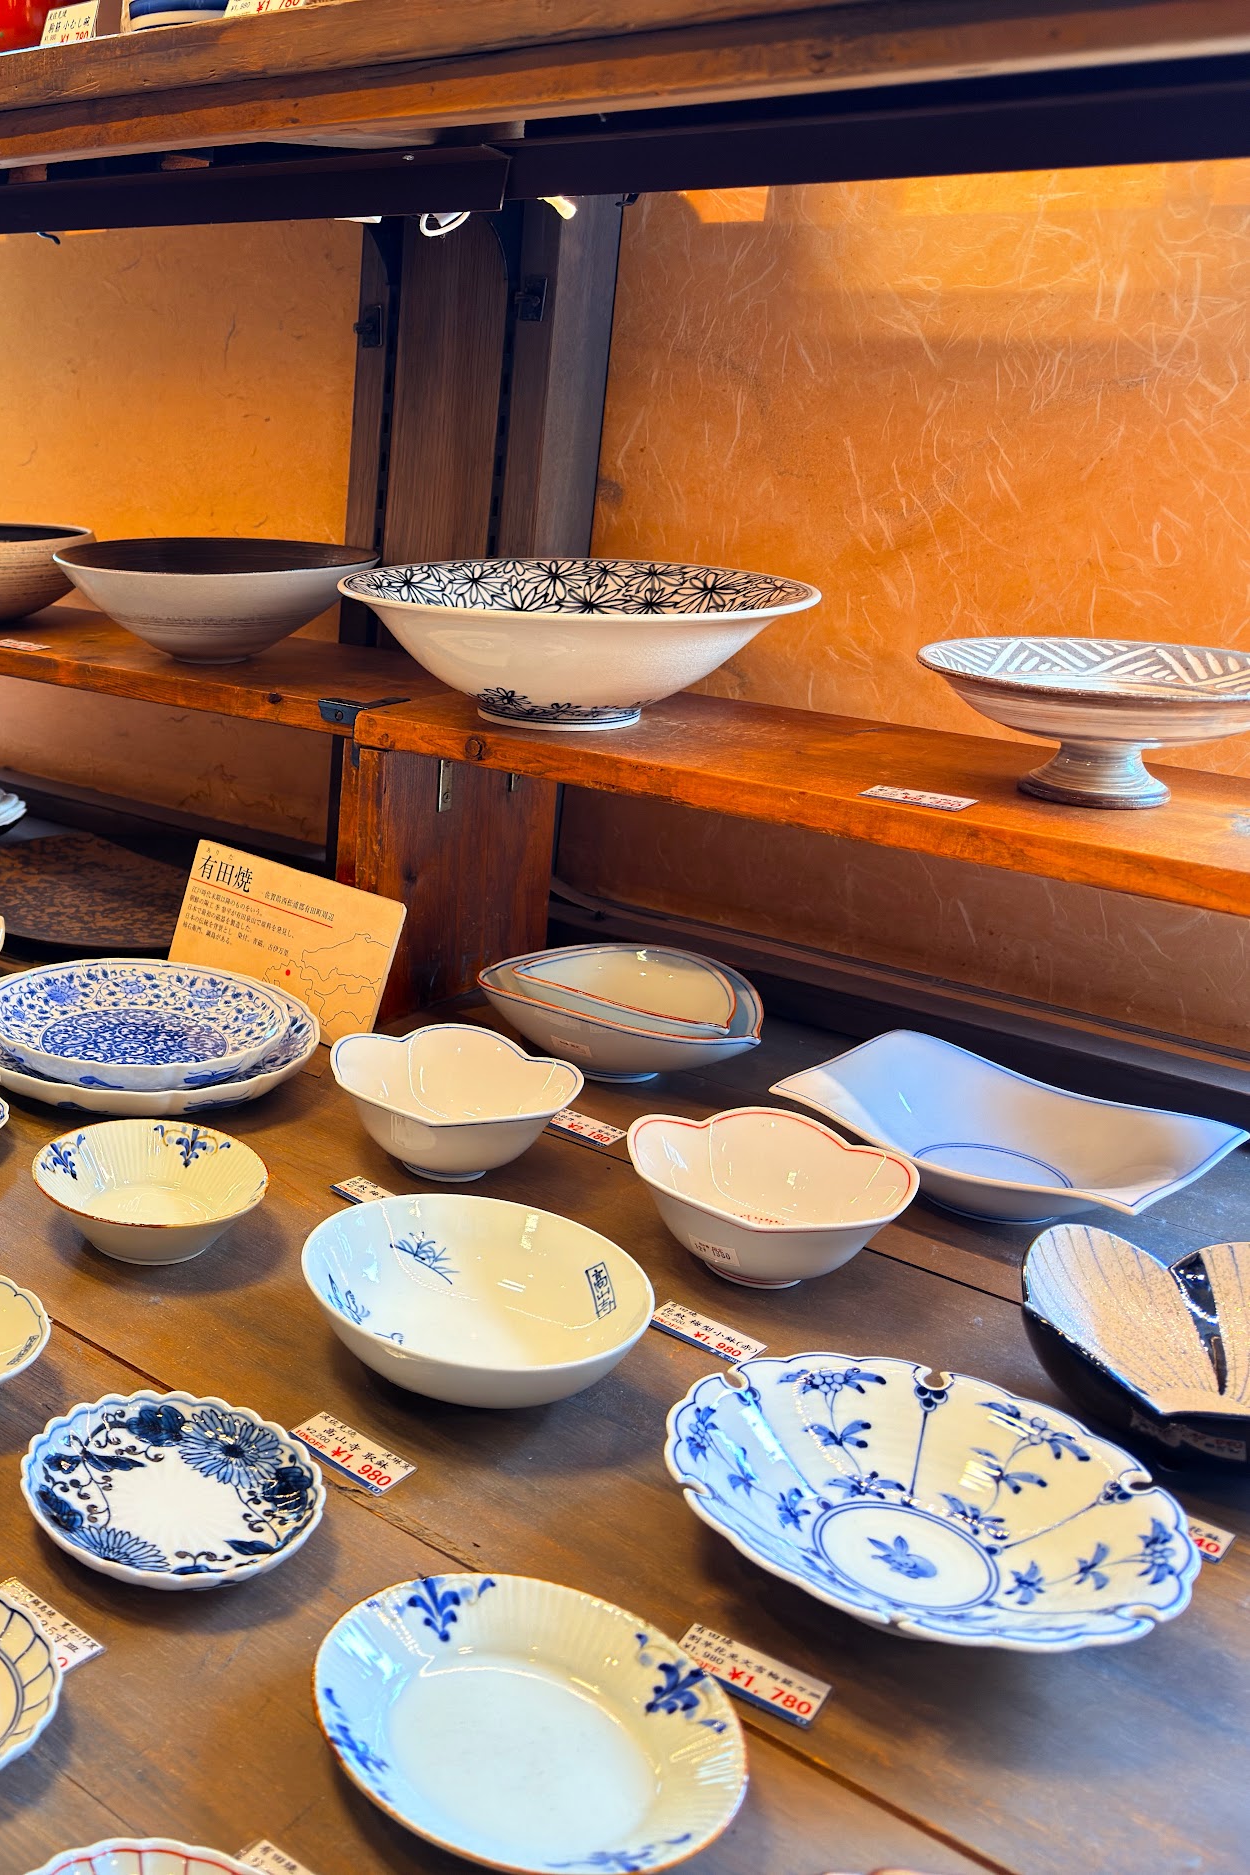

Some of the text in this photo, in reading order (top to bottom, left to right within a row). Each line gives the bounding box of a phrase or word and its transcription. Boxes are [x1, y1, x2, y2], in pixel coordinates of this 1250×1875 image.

[198, 855, 253, 893] 有田焼
[592, 1269, 615, 1312] 高山寺
[693, 1331, 742, 1357] ¥1,980
[305, 1425, 331, 1444] ¥2,200
[319, 1413, 357, 1438] 波佐見焼
[295, 1429, 327, 1450] 10%OFF
[322, 1427, 390, 1470] 高山寺 取鉢
[331, 1446, 392, 1487] ¥1,980
[367, 1483, 382, 1493] TO
[694, 1626, 735, 1648] 有田焼
[683, 1642, 724, 1665] ¥1,980
[728, 1666, 813, 1716] ¥1,780
